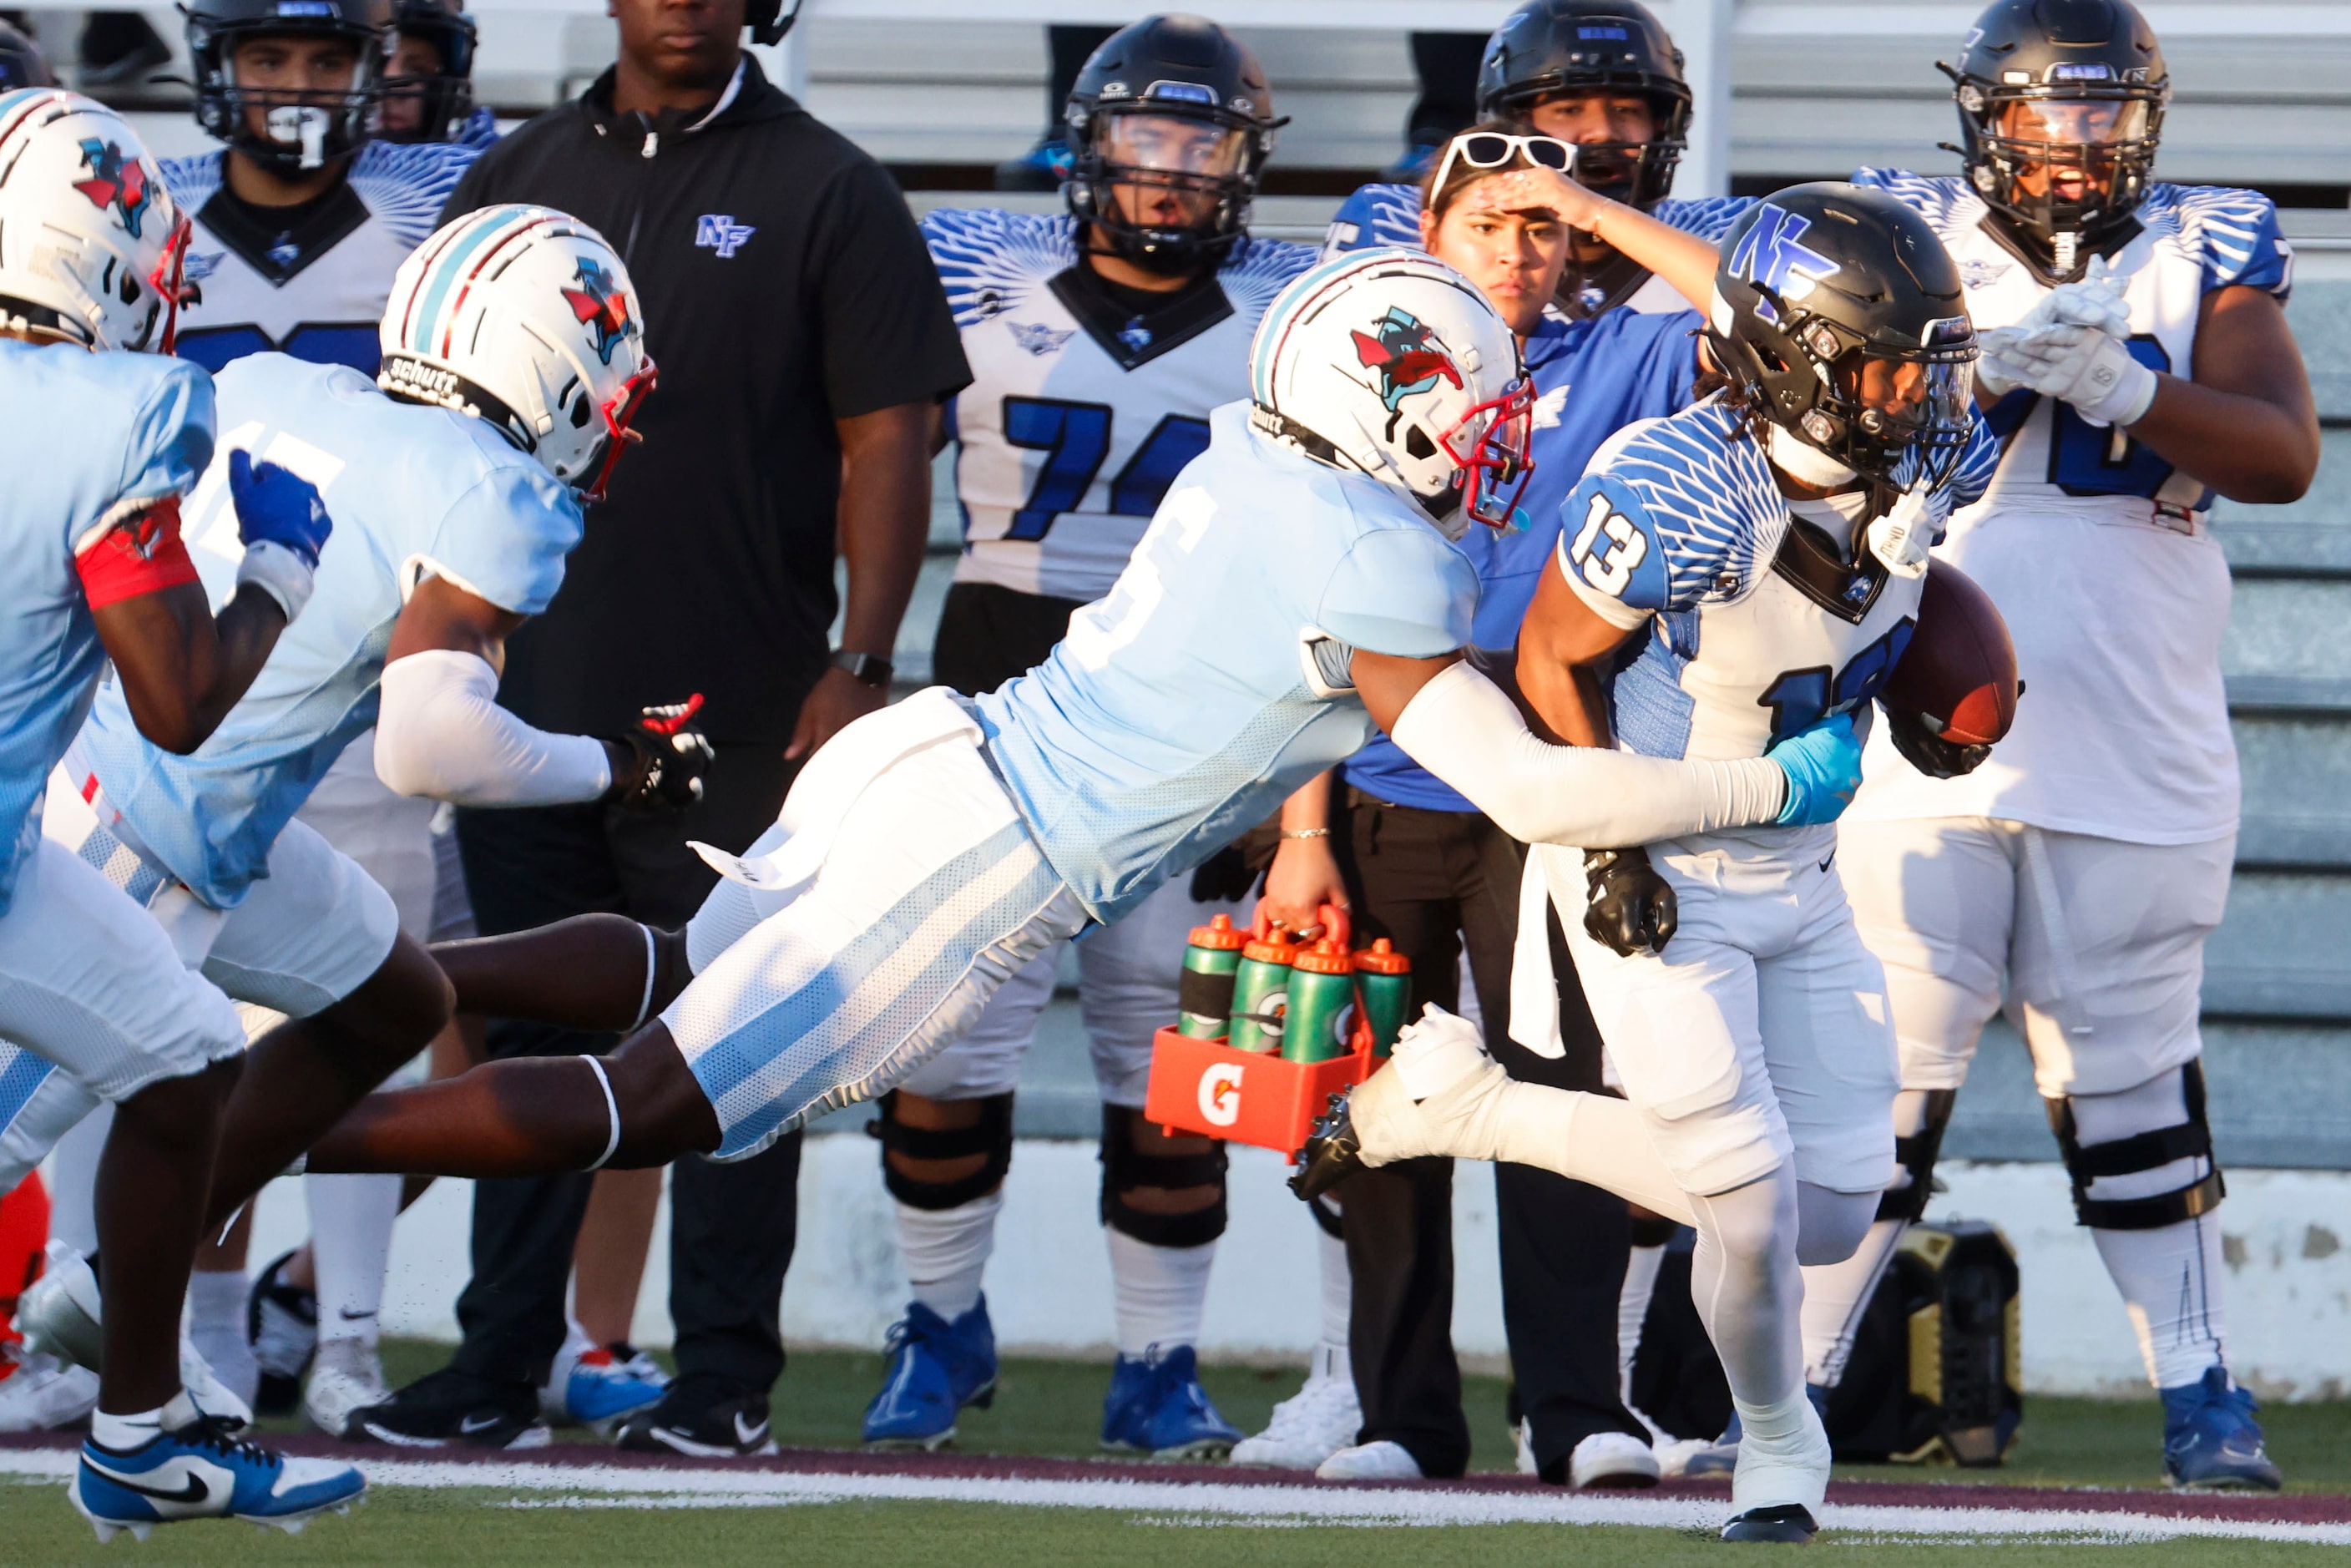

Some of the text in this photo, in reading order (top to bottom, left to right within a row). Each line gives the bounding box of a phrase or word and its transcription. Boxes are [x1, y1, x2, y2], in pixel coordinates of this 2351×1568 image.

[695, 213, 756, 259] NF
[1727, 202, 1842, 327] NF
[390, 357, 458, 395] schutt
[1569, 490, 1649, 598] 13
[1198, 1062, 1245, 1126] G
